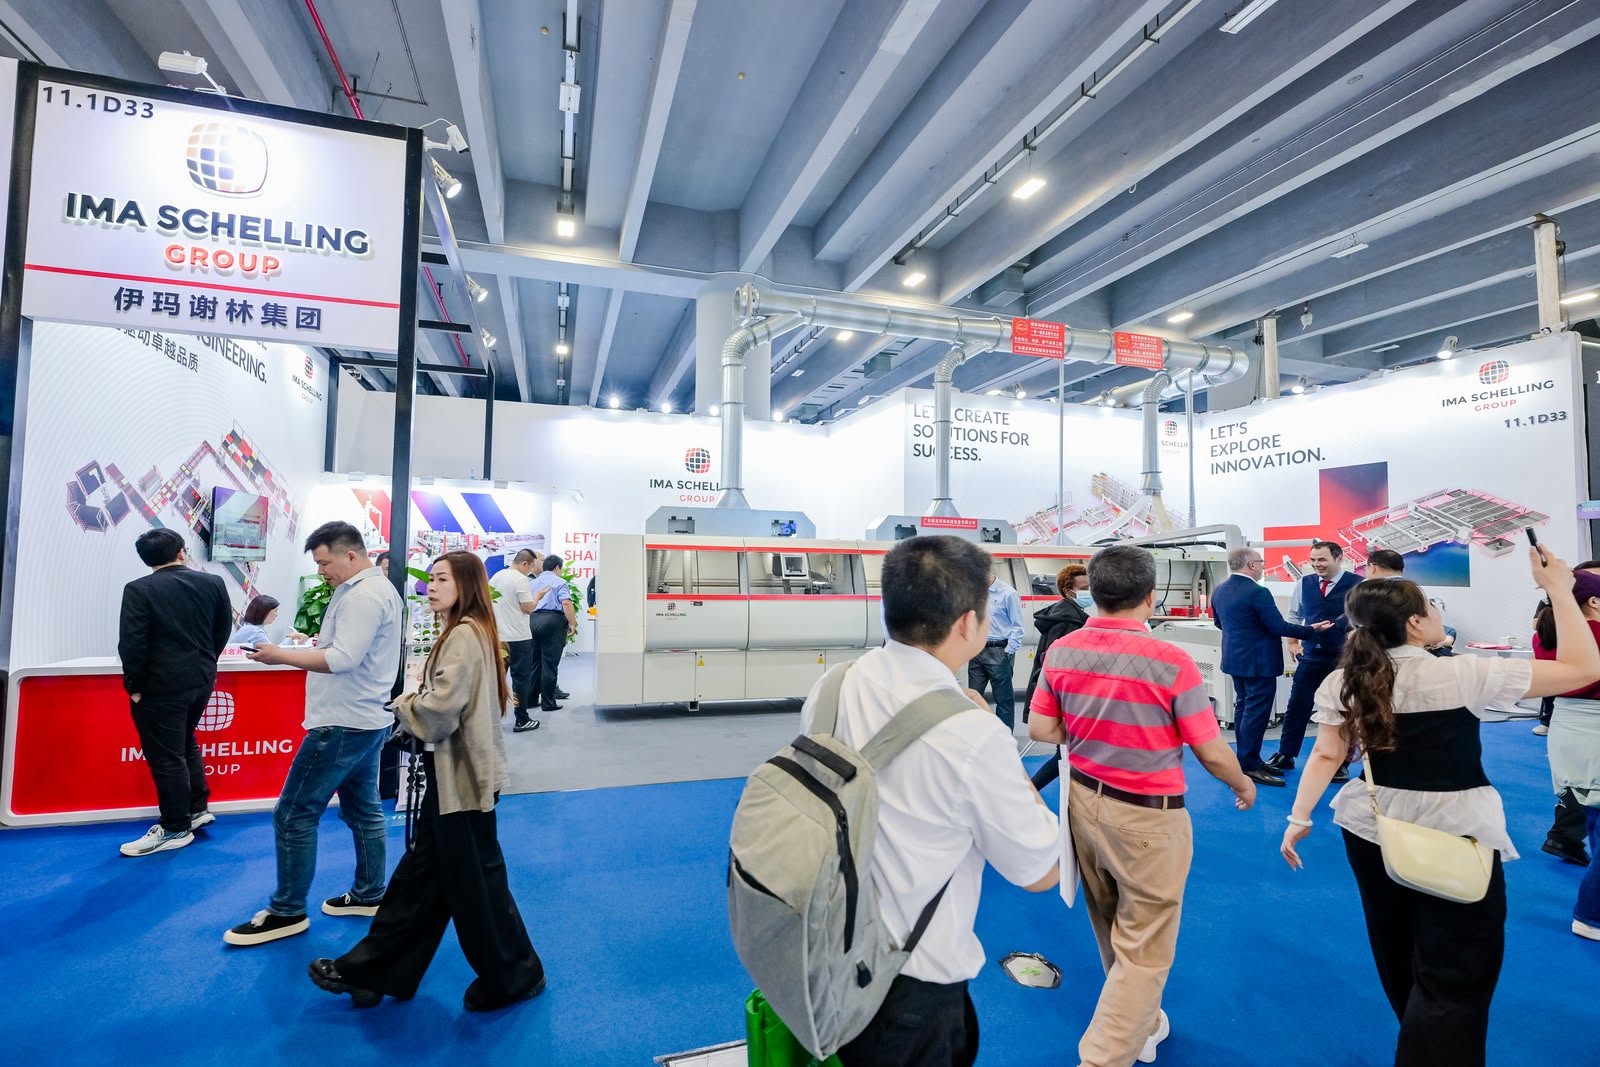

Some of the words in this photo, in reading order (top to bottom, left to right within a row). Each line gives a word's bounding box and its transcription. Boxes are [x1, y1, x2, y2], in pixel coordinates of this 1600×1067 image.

[42, 86, 154, 119] 11.1D33
[66, 192, 146, 228] IMA
[157, 205, 369, 255] SCHELLING
[165, 244, 281, 275] GROUP
[113, 287, 322, 331] 伊玛谢林集团
[196, 336, 267, 384] GINEERING.
[1442, 396, 1467, 407] IMA
[1471, 380, 1555, 403] SCHELLING
[954, 408, 1010, 426] CREATE
[1474, 399, 1518, 412] GROUP
[1210, 421, 1248, 441] LET'S
[1504, 410, 1568, 429] 11.1D33
[913, 424, 998, 444] SOTIONS
[1001, 431, 1030, 447] FOR
[1210, 434, 1282, 458] EXPLORE
[912, 443, 982, 462] SUESS.
[1210, 447, 1326, 476] INNOVATION.
[649, 478, 674, 490] IMA
[677, 480, 721, 491] SCHELL
[679, 494, 716, 503] GROUP
[564, 549, 597, 561] SHA
[121, 747, 147, 762] IM
[197, 739, 293, 758] HELLING
[204, 763, 241, 776] OUP
